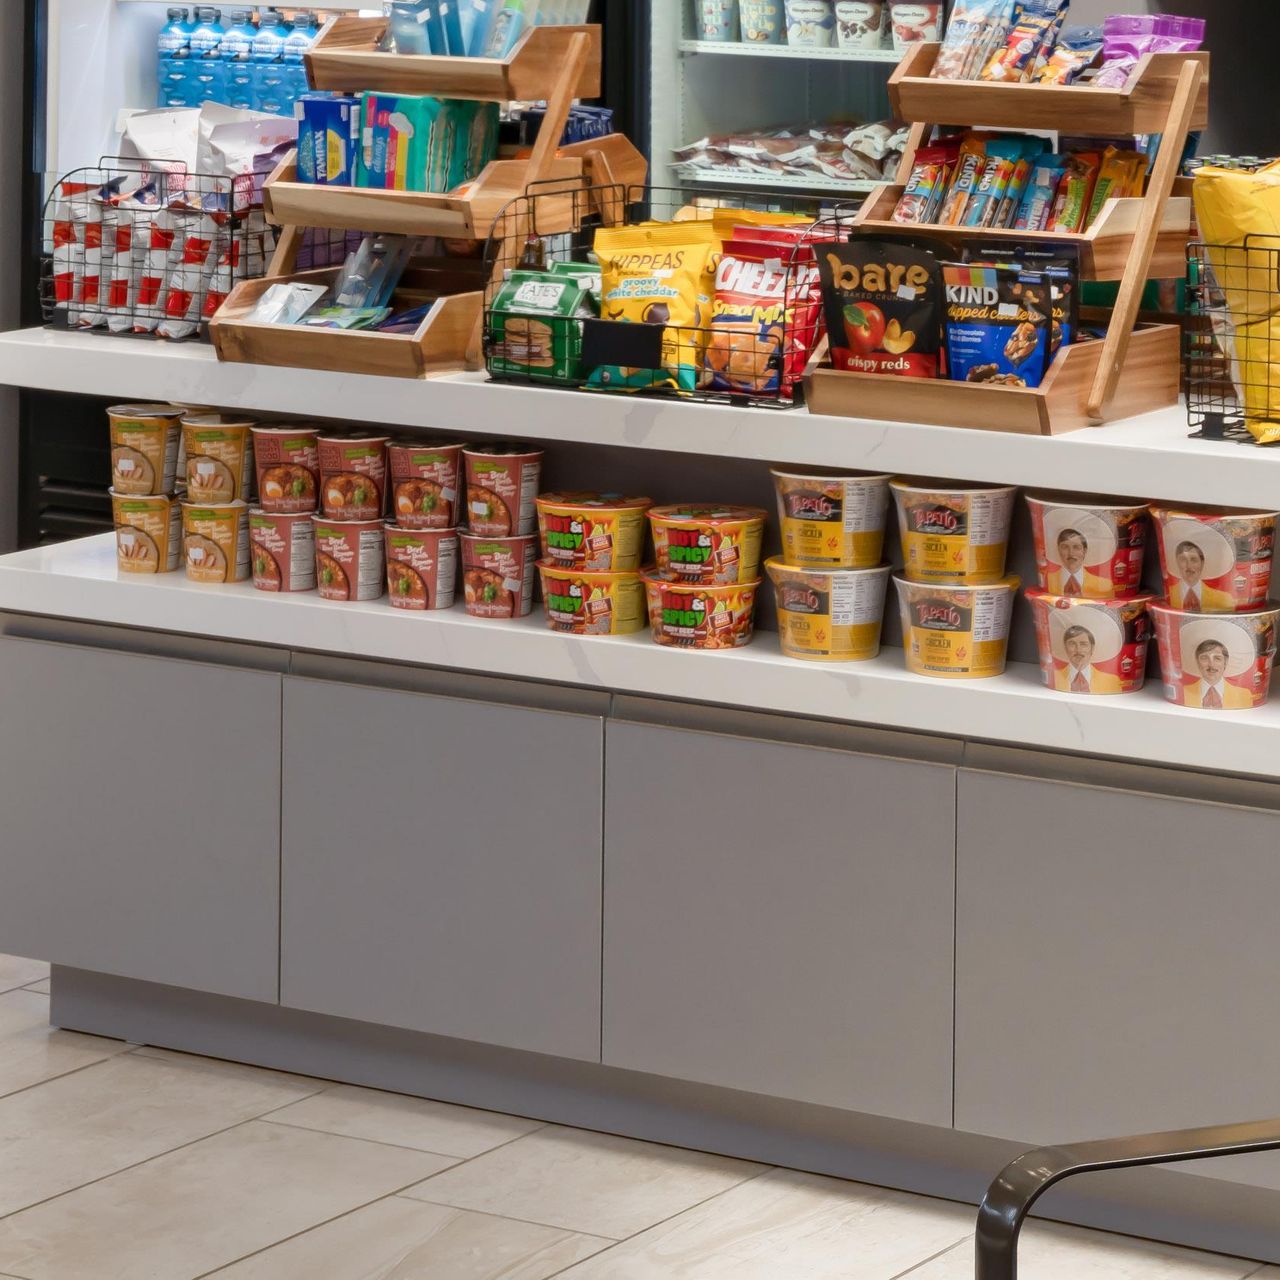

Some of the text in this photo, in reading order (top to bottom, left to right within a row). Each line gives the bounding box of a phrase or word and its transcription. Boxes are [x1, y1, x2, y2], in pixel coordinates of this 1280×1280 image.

[315, 129, 327, 180] TAMPAX
[959, 154, 977, 187] KIND
[978, 156, 999, 192] KIND
[610, 250, 685, 270] HIPPEAS
[827, 253, 929, 293] bare
[623, 278, 660, 288] groovy
[608, 287, 679, 299] white cheddar
[842, 291, 873, 299] BAKED
[945, 285, 999, 306] KIND
[752, 303, 795, 325] Mix
[947, 305, 988, 321] dipped
[847, 356, 911, 371] crispy reds
[545, 514, 582, 533] HOT &
[547, 531, 583, 548] SPICY
[668, 528, 712, 547] HOT &
[669, 546, 711, 563] SPICY
[922, 542, 948, 552] CHICKEN
[546, 577, 582, 596] HOT &
[547, 595, 583, 613] SPICY
[662, 591, 705, 611] HOT &
[662, 609, 706, 627] SPICY
[925, 638, 952, 649] CHICKEN
